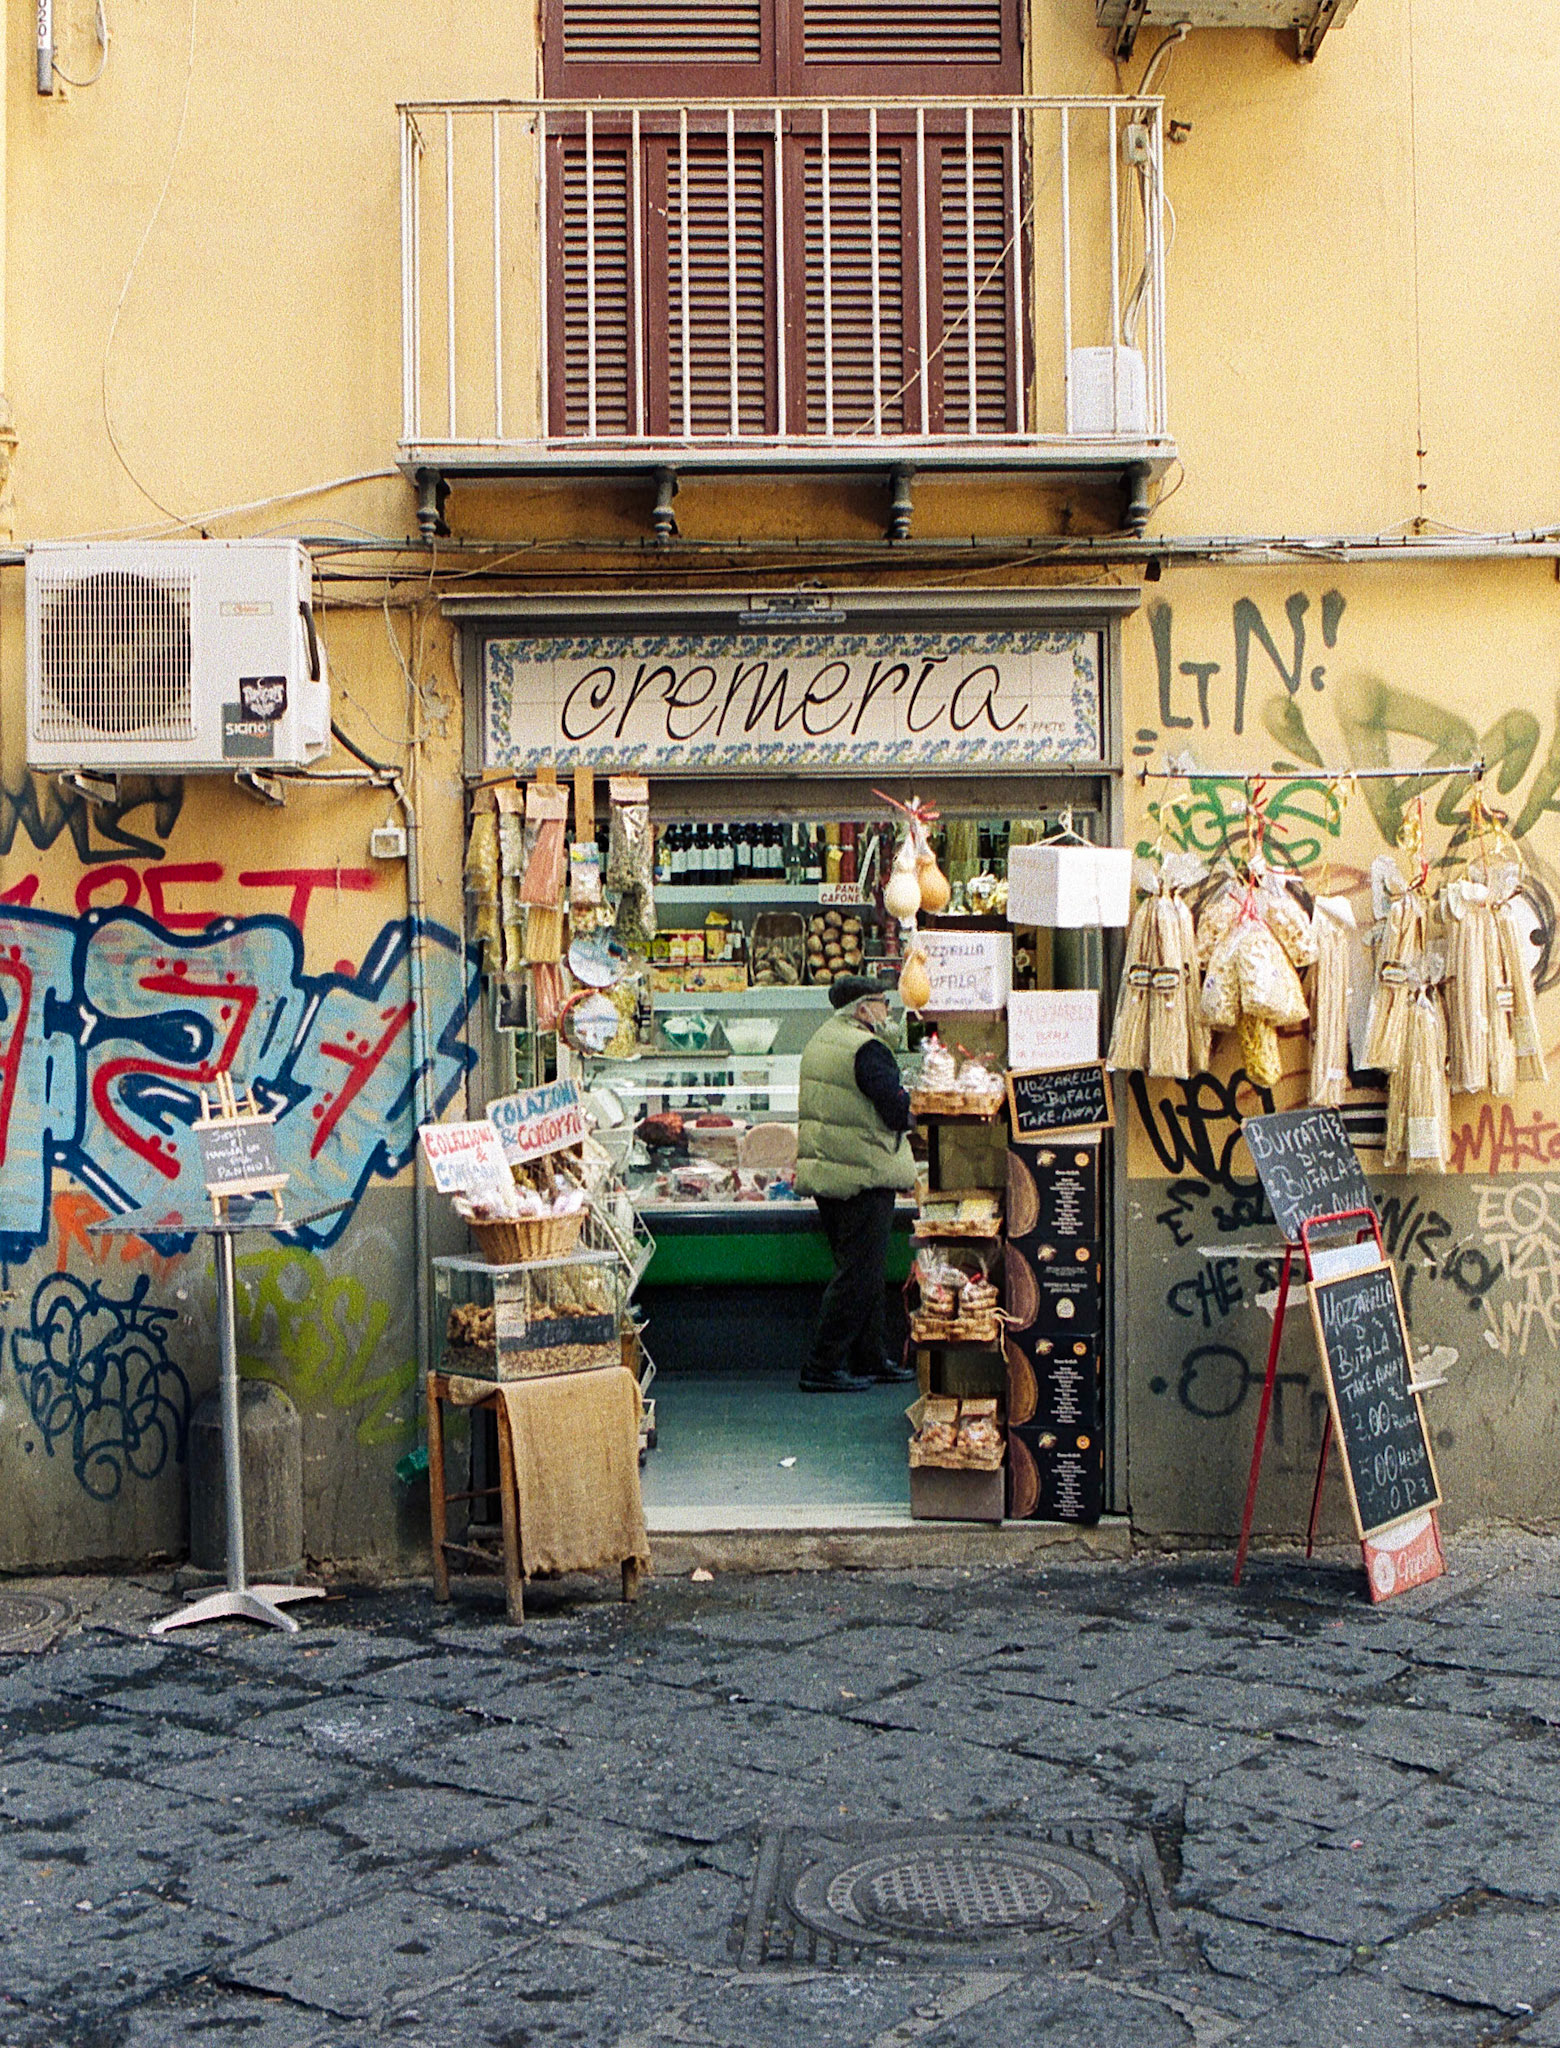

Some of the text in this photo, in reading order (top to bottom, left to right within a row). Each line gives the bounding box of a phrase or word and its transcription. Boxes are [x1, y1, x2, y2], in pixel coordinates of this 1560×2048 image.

[561, 657, 1029, 740] cremeria
[1016, 1069, 1102, 1097] MOZZARELLA
[1043, 1087, 1102, 1107] BUFALA
